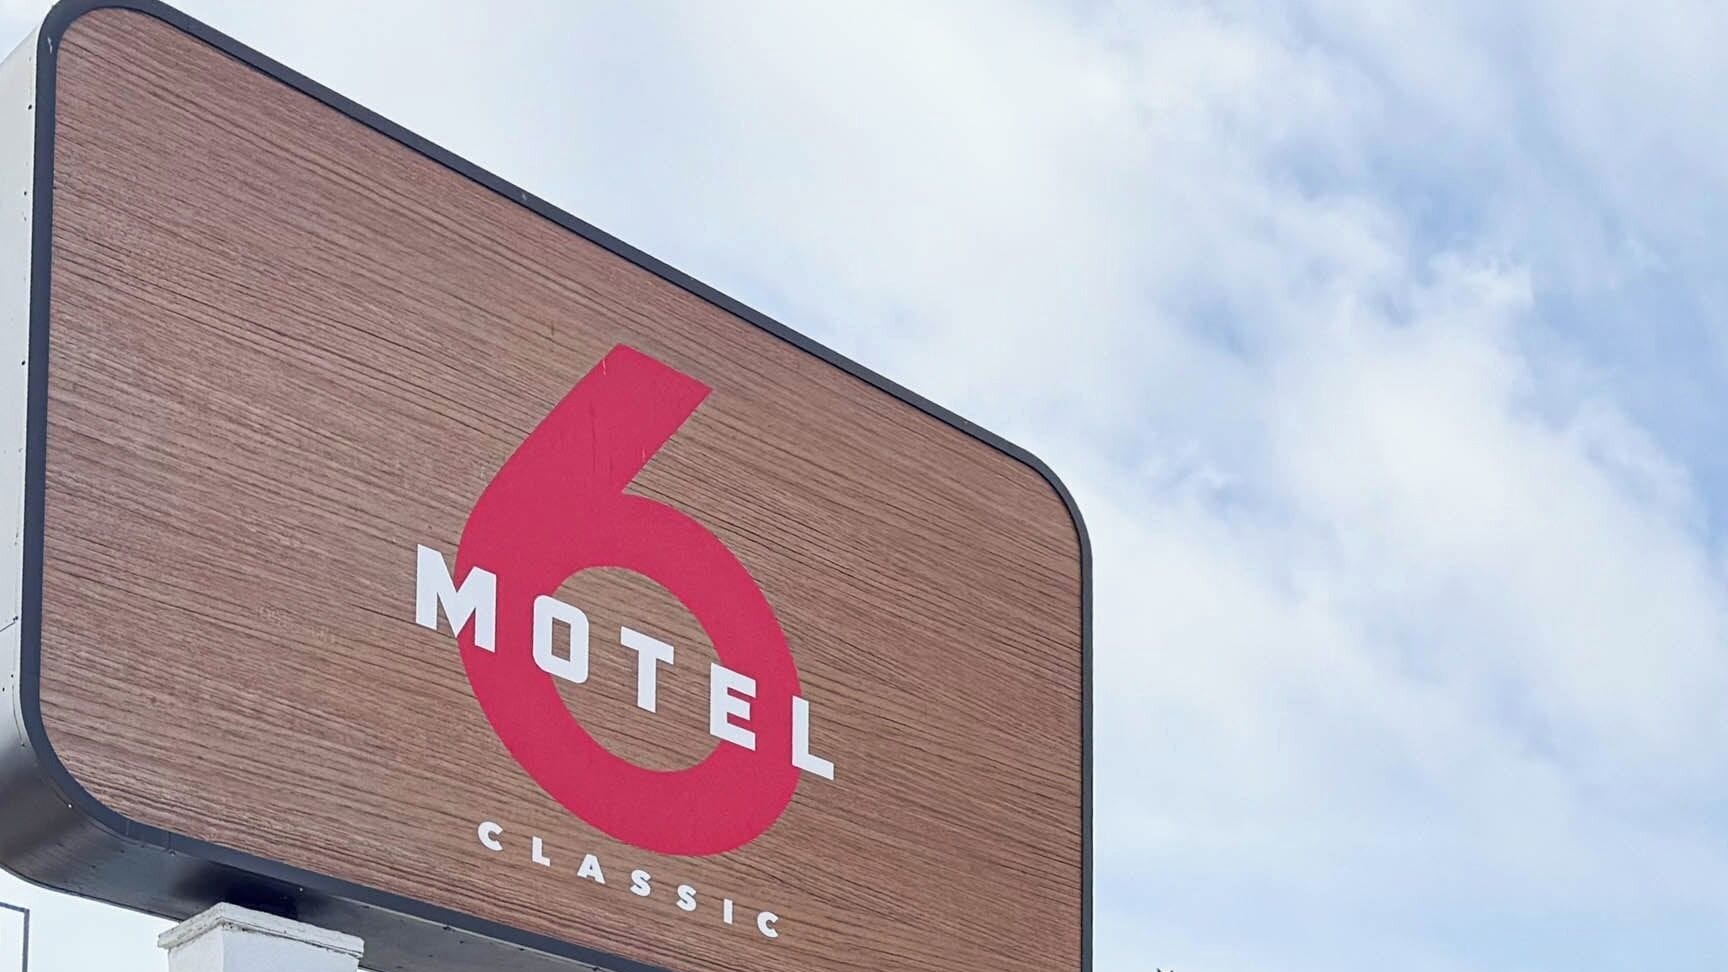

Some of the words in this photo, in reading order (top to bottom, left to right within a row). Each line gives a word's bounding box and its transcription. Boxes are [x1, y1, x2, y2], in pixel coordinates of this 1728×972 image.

[415, 543, 835, 781] MOTEL
[454, 343, 802, 858] 6
[477, 821, 780, 938] CLASSIC
